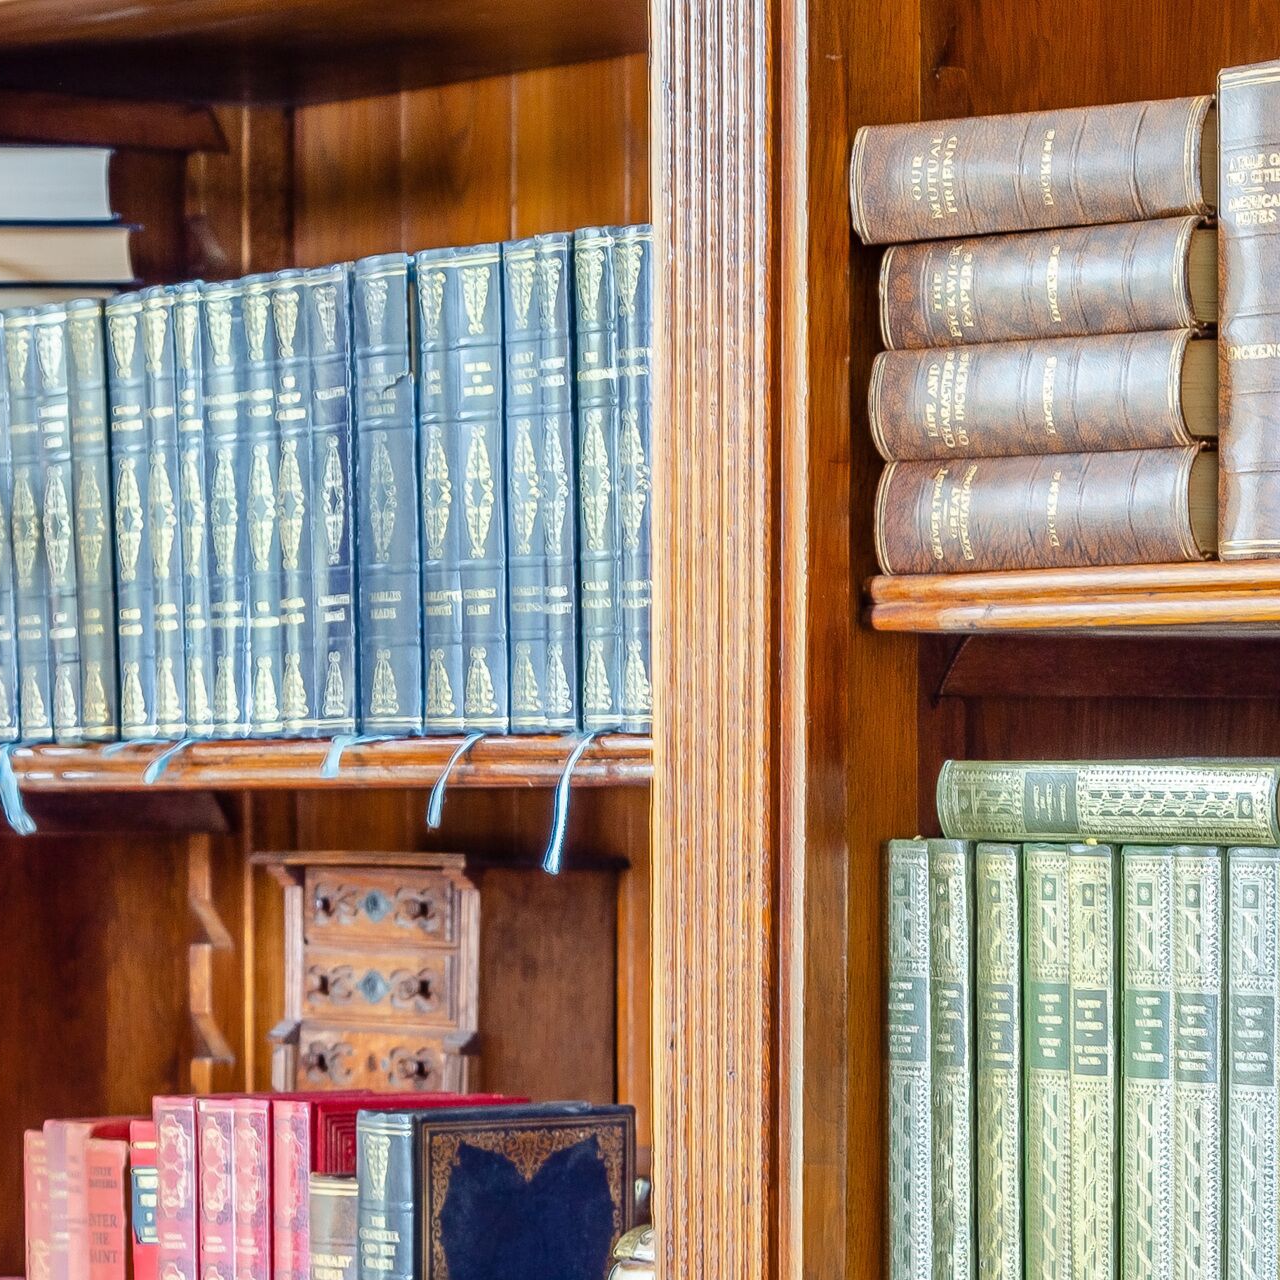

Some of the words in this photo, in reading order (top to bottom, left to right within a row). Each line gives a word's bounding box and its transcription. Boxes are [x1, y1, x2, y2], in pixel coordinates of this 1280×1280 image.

[912, 154, 924, 201] OUR
[927, 131, 944, 219] MUTUAL
[943, 136, 958, 214] FRIEND
[1040, 129, 1056, 206] DICKENS
[932, 272, 944, 313] THE
[946, 244, 963, 338] PICKWICK
[960, 252, 974, 328] PAPERS
[926, 362, 940, 399] AND
[940, 351, 956, 448] CHARACTERS
[954, 352, 970, 421] DICKENS
[924, 402, 939, 438] LIFE
[956, 427, 969, 447] OF
[930, 510, 944, 561] OLIVER
[950, 487, 962, 539] GREAT
[959, 464, 978, 561] EXPECTATIONS
[1046, 470, 1062, 547] DICKENS
